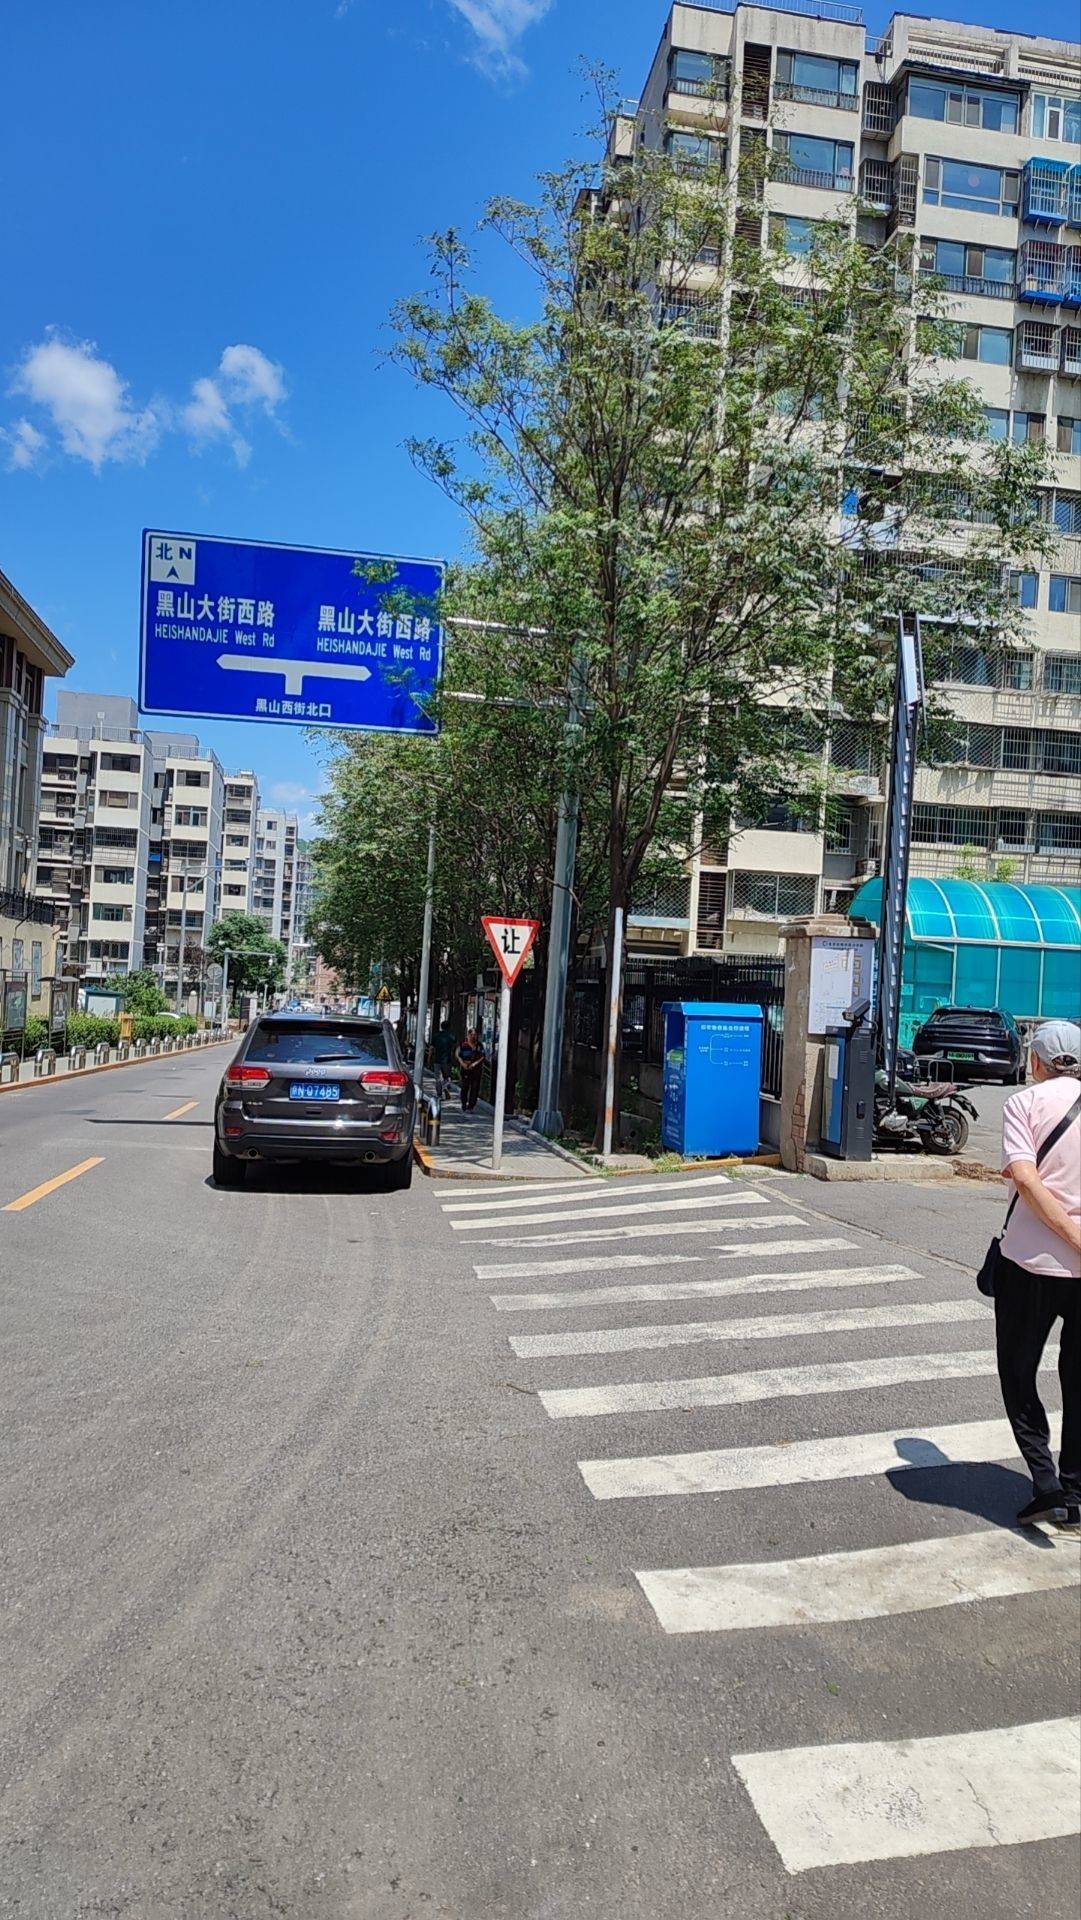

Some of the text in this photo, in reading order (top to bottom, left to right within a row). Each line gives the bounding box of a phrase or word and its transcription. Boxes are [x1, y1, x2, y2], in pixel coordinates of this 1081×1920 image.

[155, 542, 192, 560] 北 N
[156, 589, 275, 628] 黑山大街西路
[154, 623, 275, 648] HEISHANDAJIE West Rd
[318, 604, 432, 642] 黑山大街西路
[316, 637, 431, 661] HEISHANDAJIE West Rd
[255, 698, 332, 718] 黑山西街北口
[501, 928, 521, 954] 让
